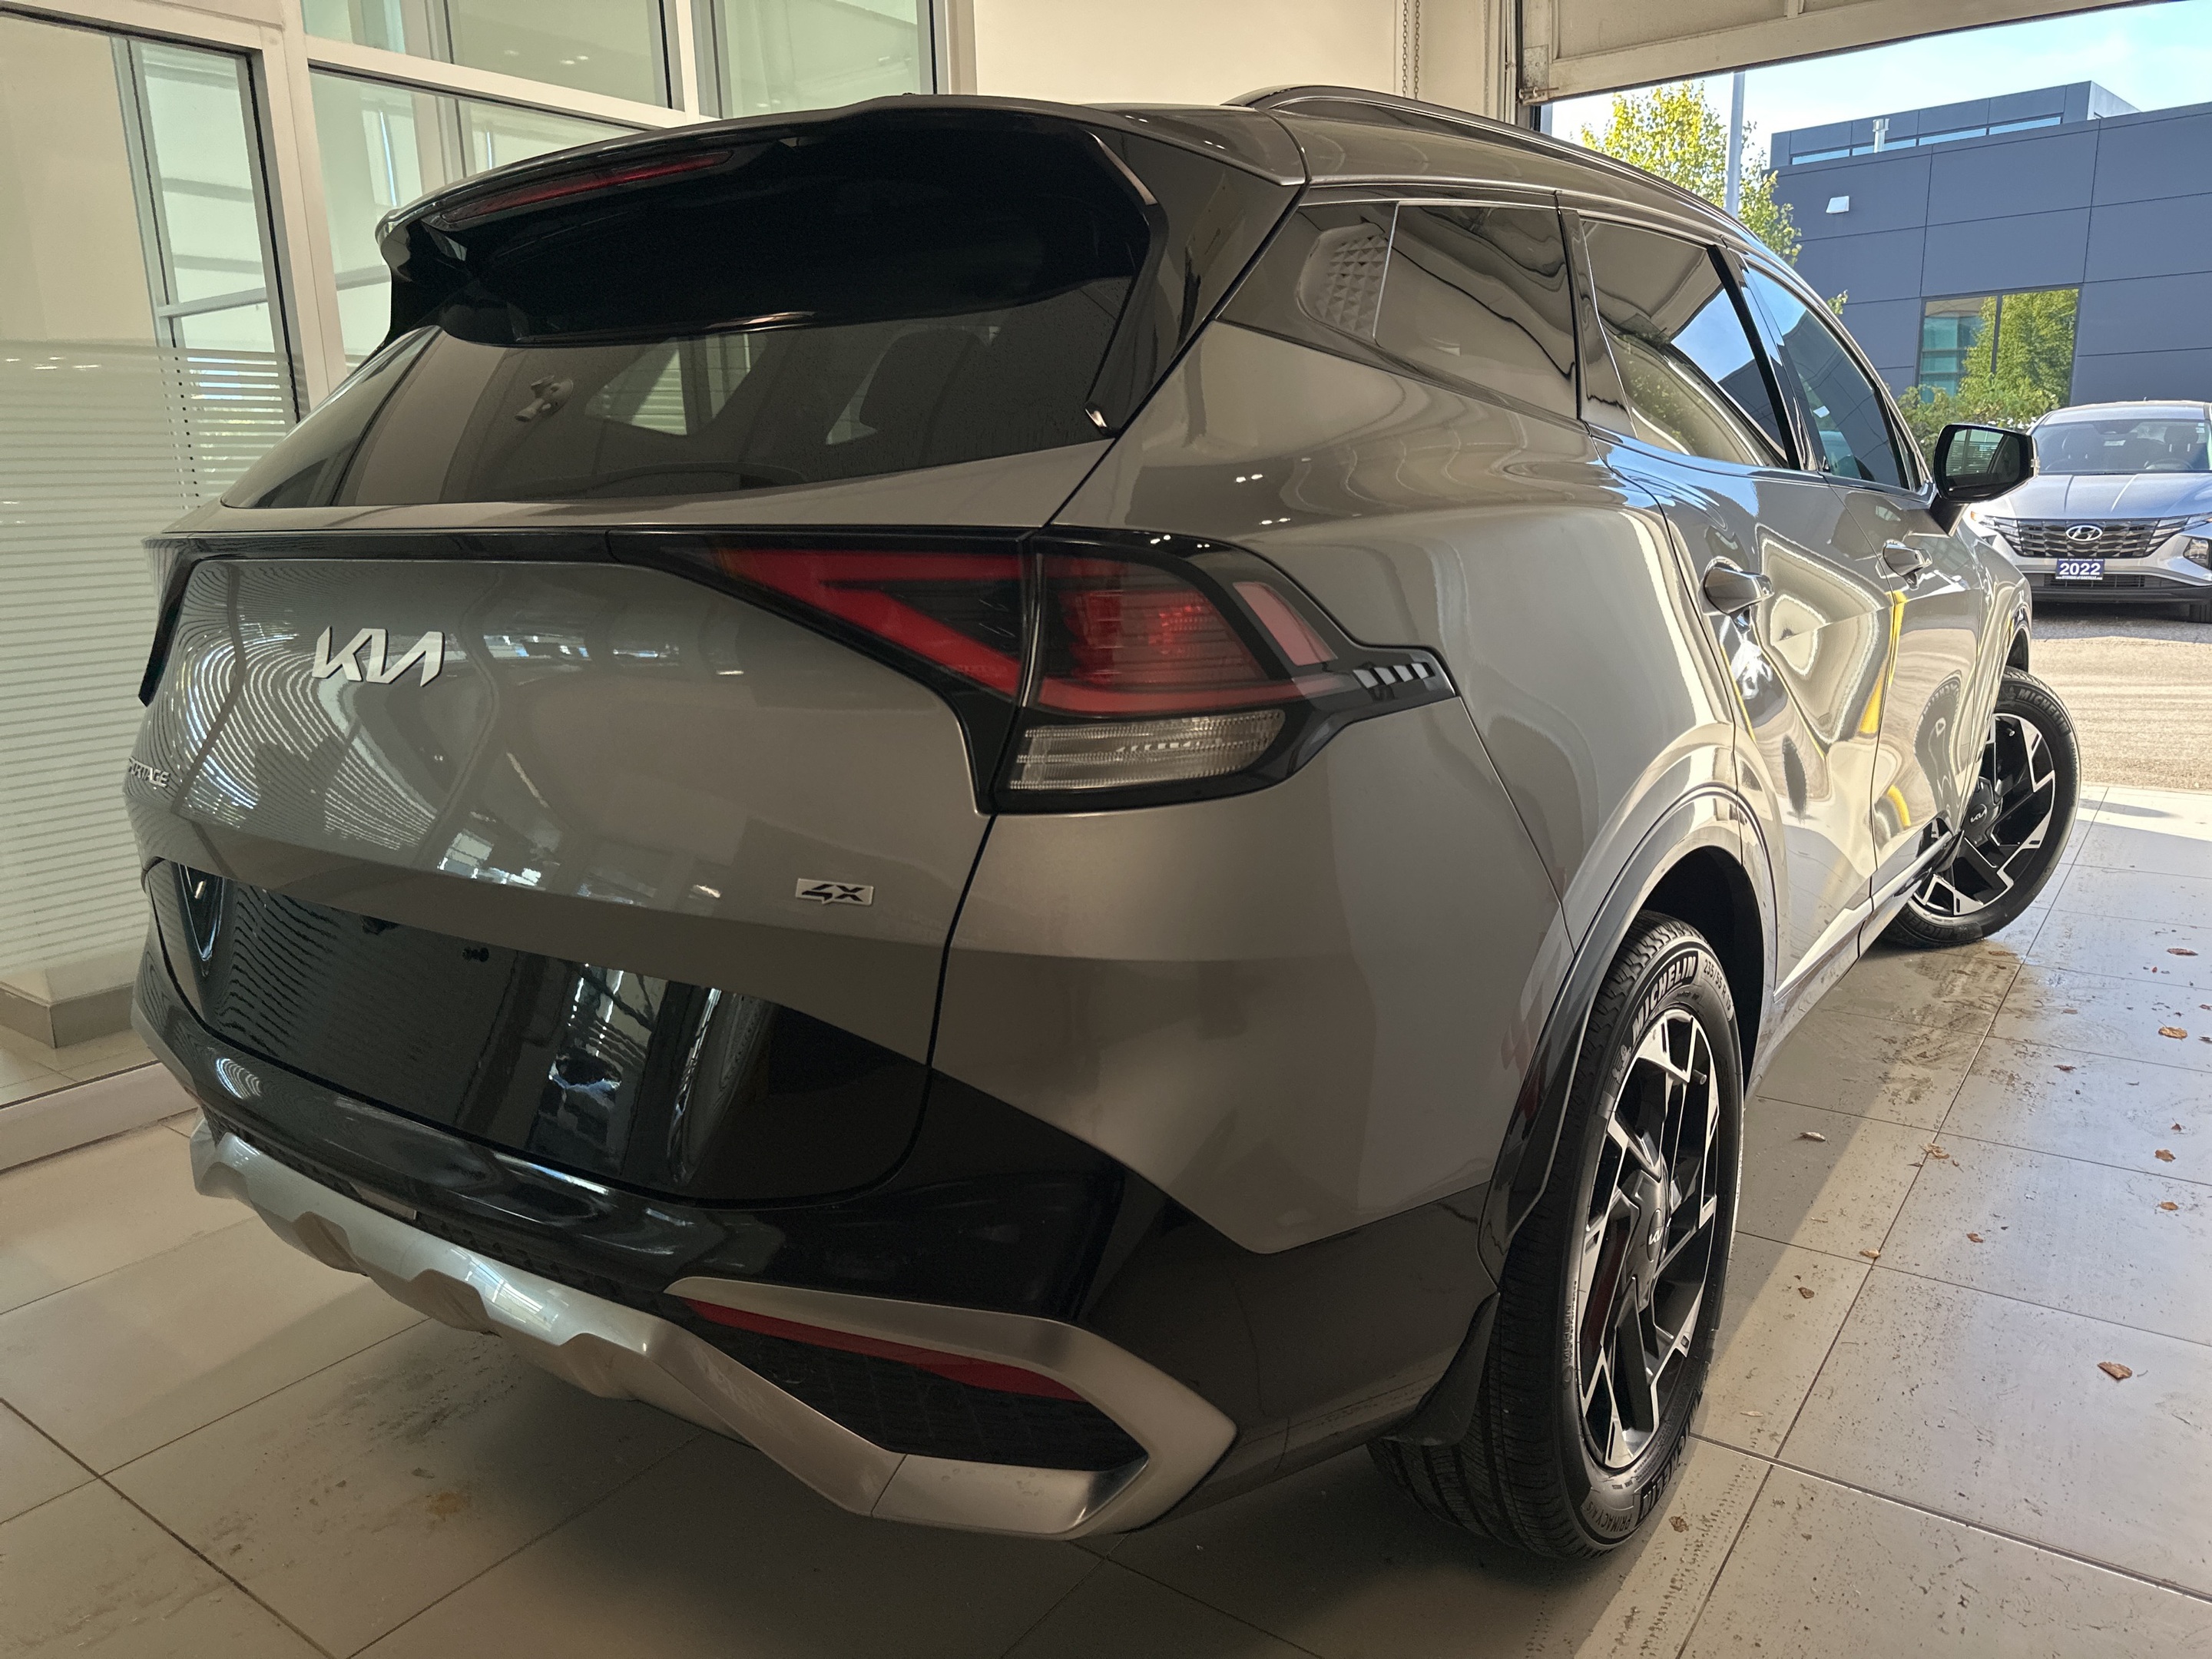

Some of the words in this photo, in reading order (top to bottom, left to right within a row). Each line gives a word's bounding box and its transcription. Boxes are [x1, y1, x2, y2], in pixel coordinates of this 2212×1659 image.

[2059, 562, 2101, 575] 2022
[311, 625, 445, 687] KIA
[2017, 688, 2070, 735] MICHELIN
[128, 756, 171, 788] ORTAGE
[1901, 906, 1953, 939] MICHEL
[1703, 959, 1723, 989] 235/55
[1632, 956, 1697, 1045] MICHELIN
[1596, 1508, 1633, 1532] PRIMACY
